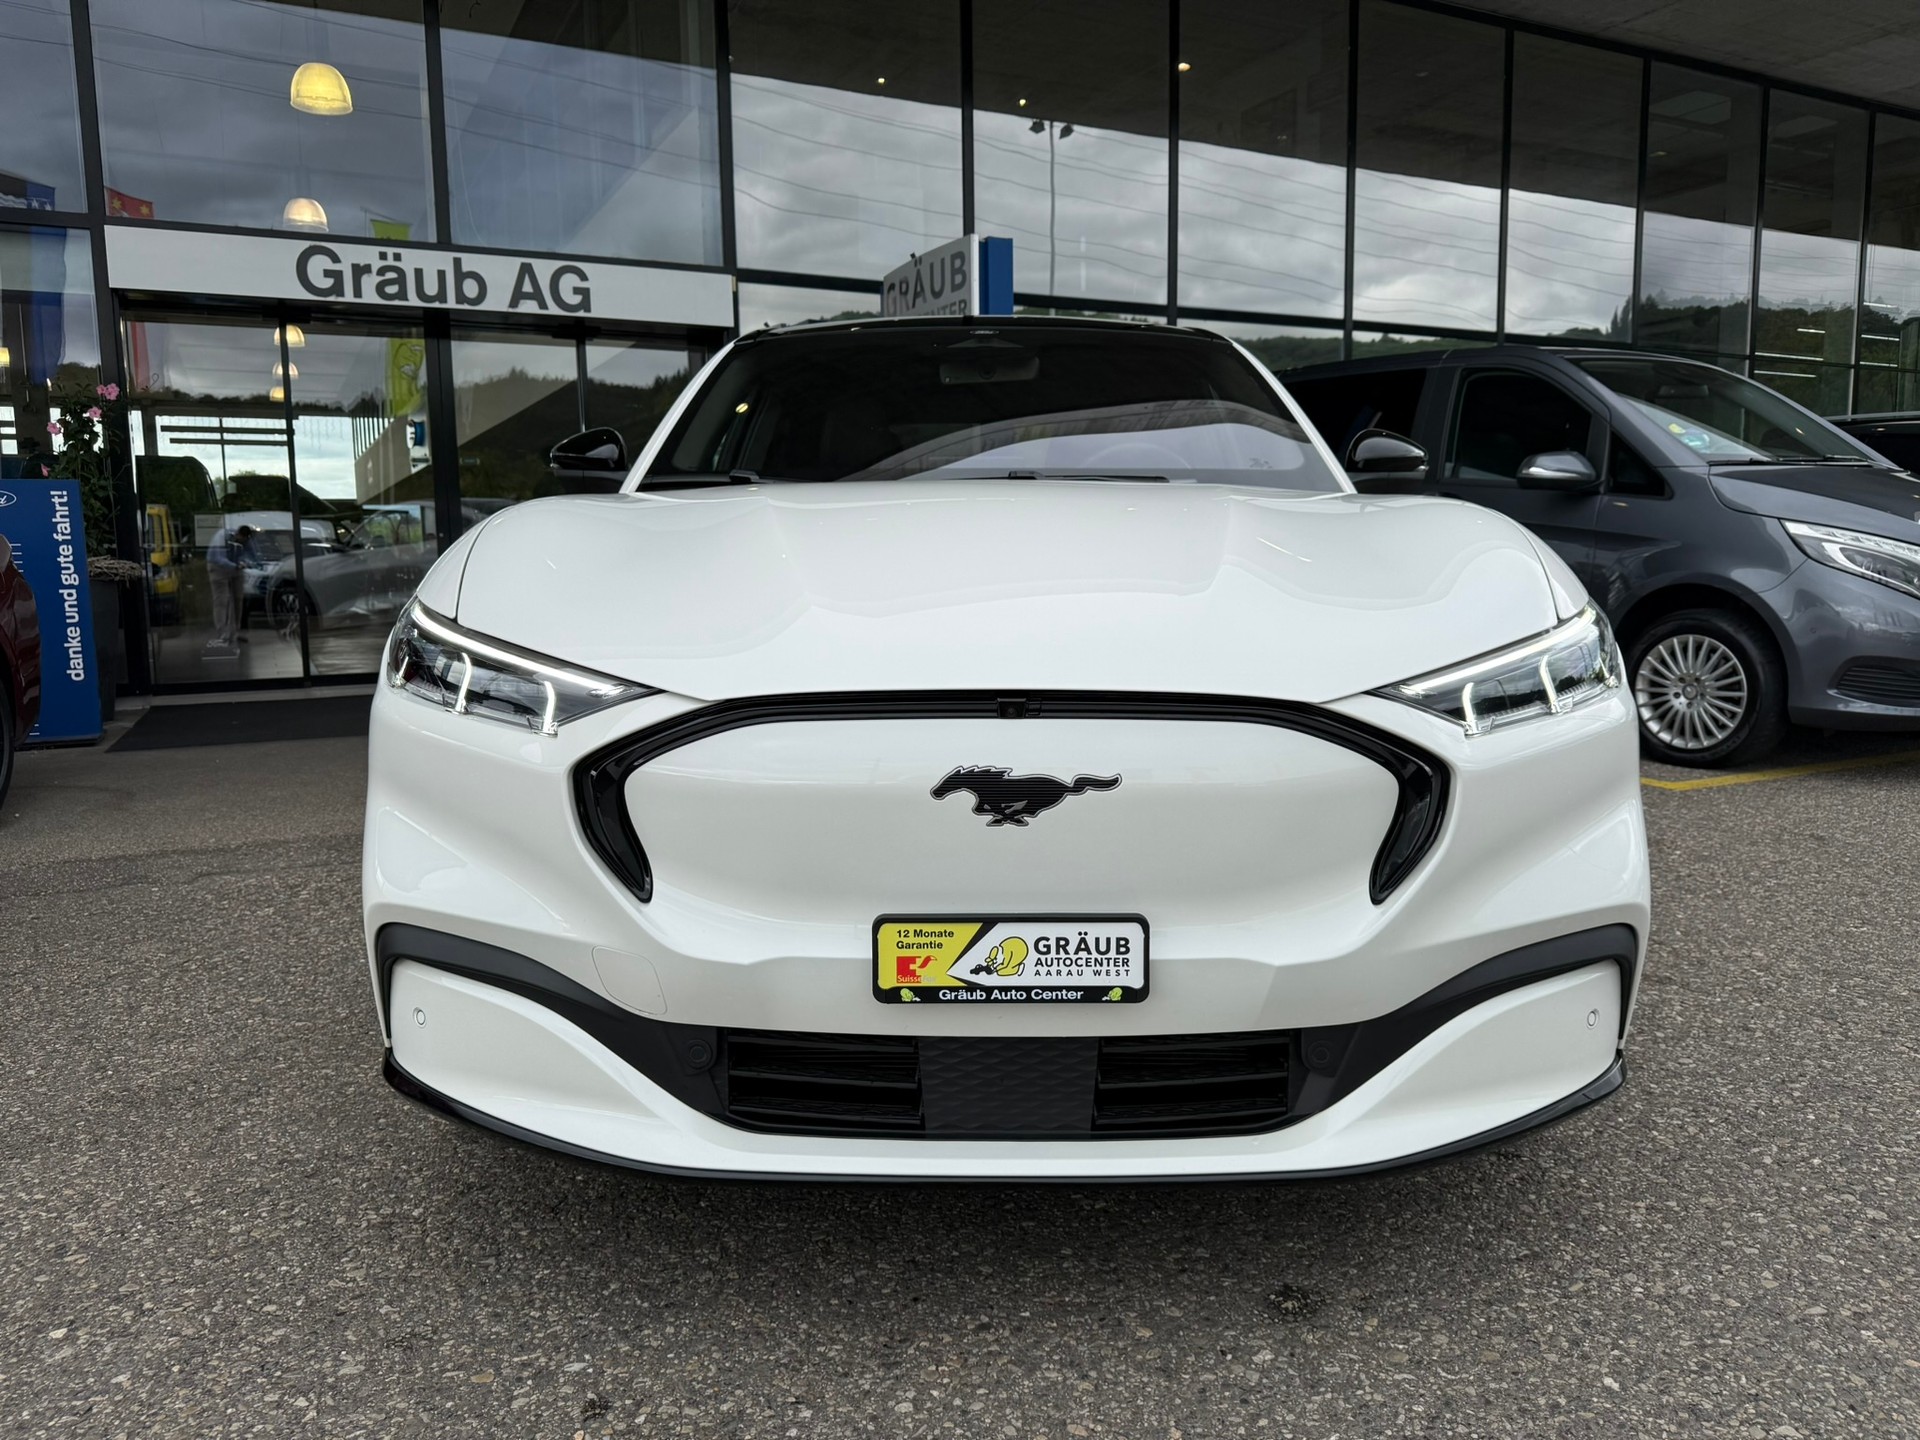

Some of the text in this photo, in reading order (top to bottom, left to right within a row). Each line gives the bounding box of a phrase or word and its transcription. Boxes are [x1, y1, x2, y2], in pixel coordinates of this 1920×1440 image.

[296, 244, 592, 314] Gräub AG
[886, 250, 967, 316] GRÄUB
[50, 490, 85, 681] danke und gute fahrt!
[896, 928, 955, 938] 12 Monate
[896, 940, 944, 950] Garantie
[1033, 931, 1131, 956] GRÄUB
[1034, 957, 1130, 968] AUTOCENTER
[1034, 969, 1131, 977] AARAU WEST
[938, 988, 1084, 1000] Gräub Auto Center
